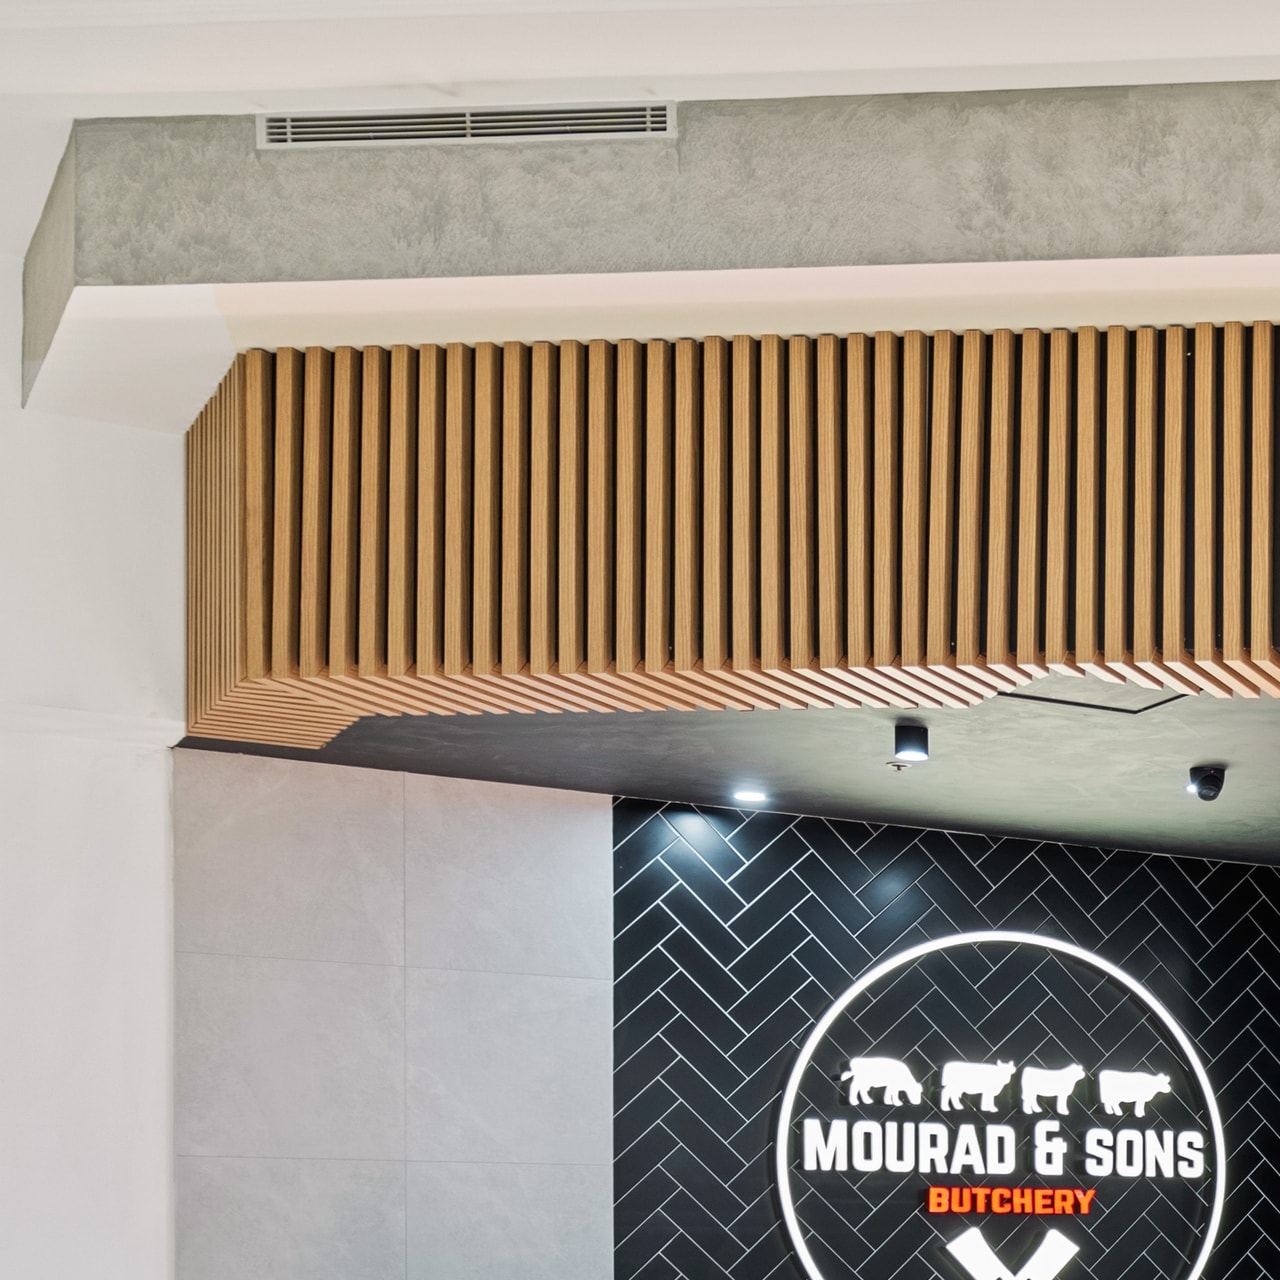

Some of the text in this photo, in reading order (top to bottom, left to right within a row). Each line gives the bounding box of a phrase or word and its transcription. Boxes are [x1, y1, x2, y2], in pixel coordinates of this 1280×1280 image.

[803, 1118, 1205, 1179] MOURAD & SONS
[928, 1186, 1096, 1215] BUTCHERY
